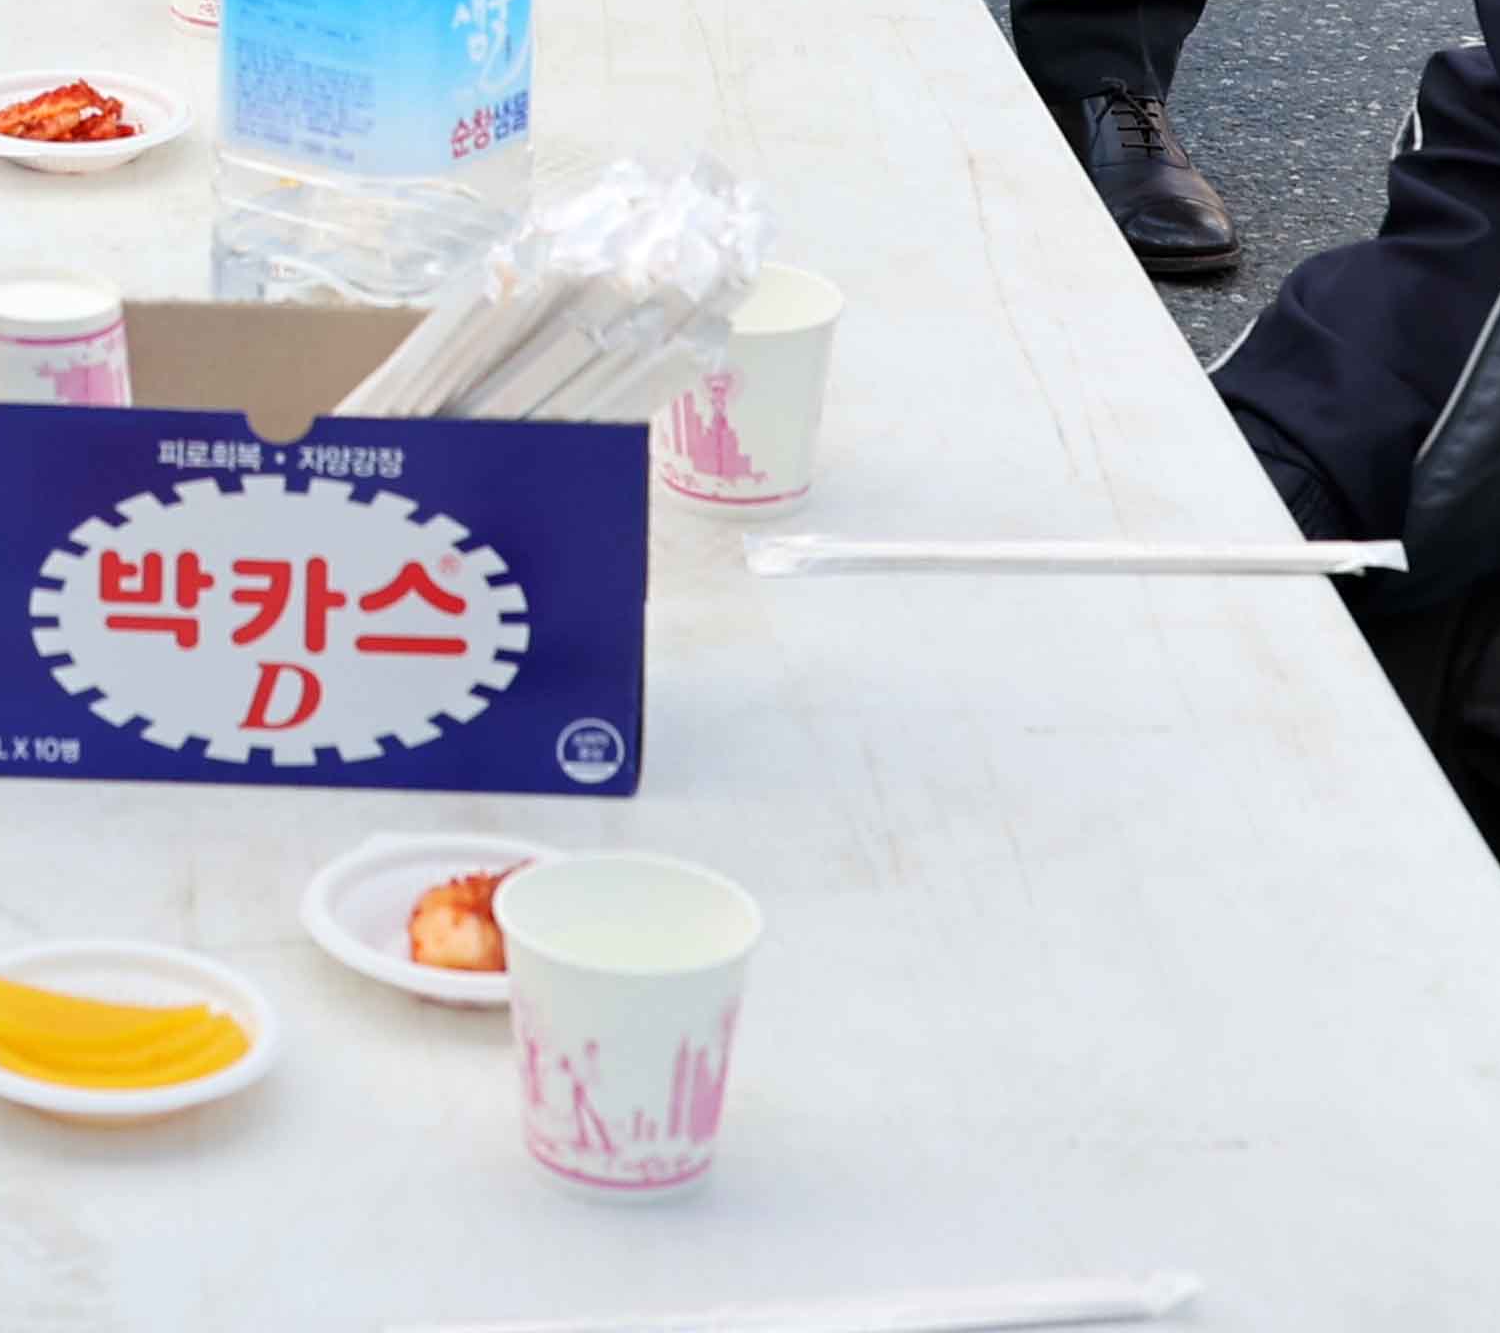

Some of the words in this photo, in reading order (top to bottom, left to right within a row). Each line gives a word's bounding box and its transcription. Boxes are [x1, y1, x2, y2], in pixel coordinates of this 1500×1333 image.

[158, 440, 262, 472] 피로회복
[298, 445, 404, 478] 자양강장
[99, 549, 468, 655] 박카스
[237, 662, 323, 731] D
